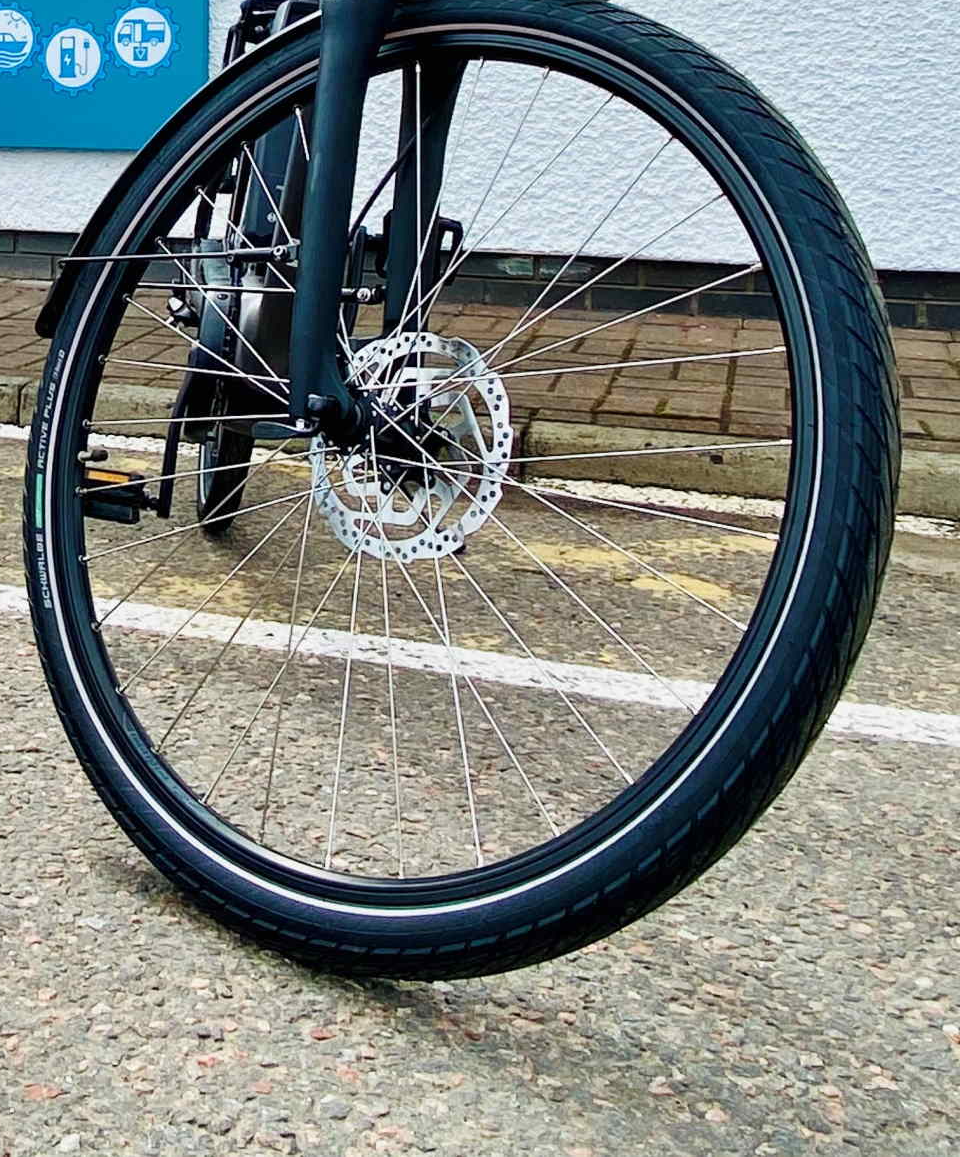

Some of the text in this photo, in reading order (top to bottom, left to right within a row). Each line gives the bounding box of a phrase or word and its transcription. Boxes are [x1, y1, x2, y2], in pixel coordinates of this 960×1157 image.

[36, 382, 56, 469] ACTIVE PLUS
[35, 533, 52, 609] SCHWALBE
